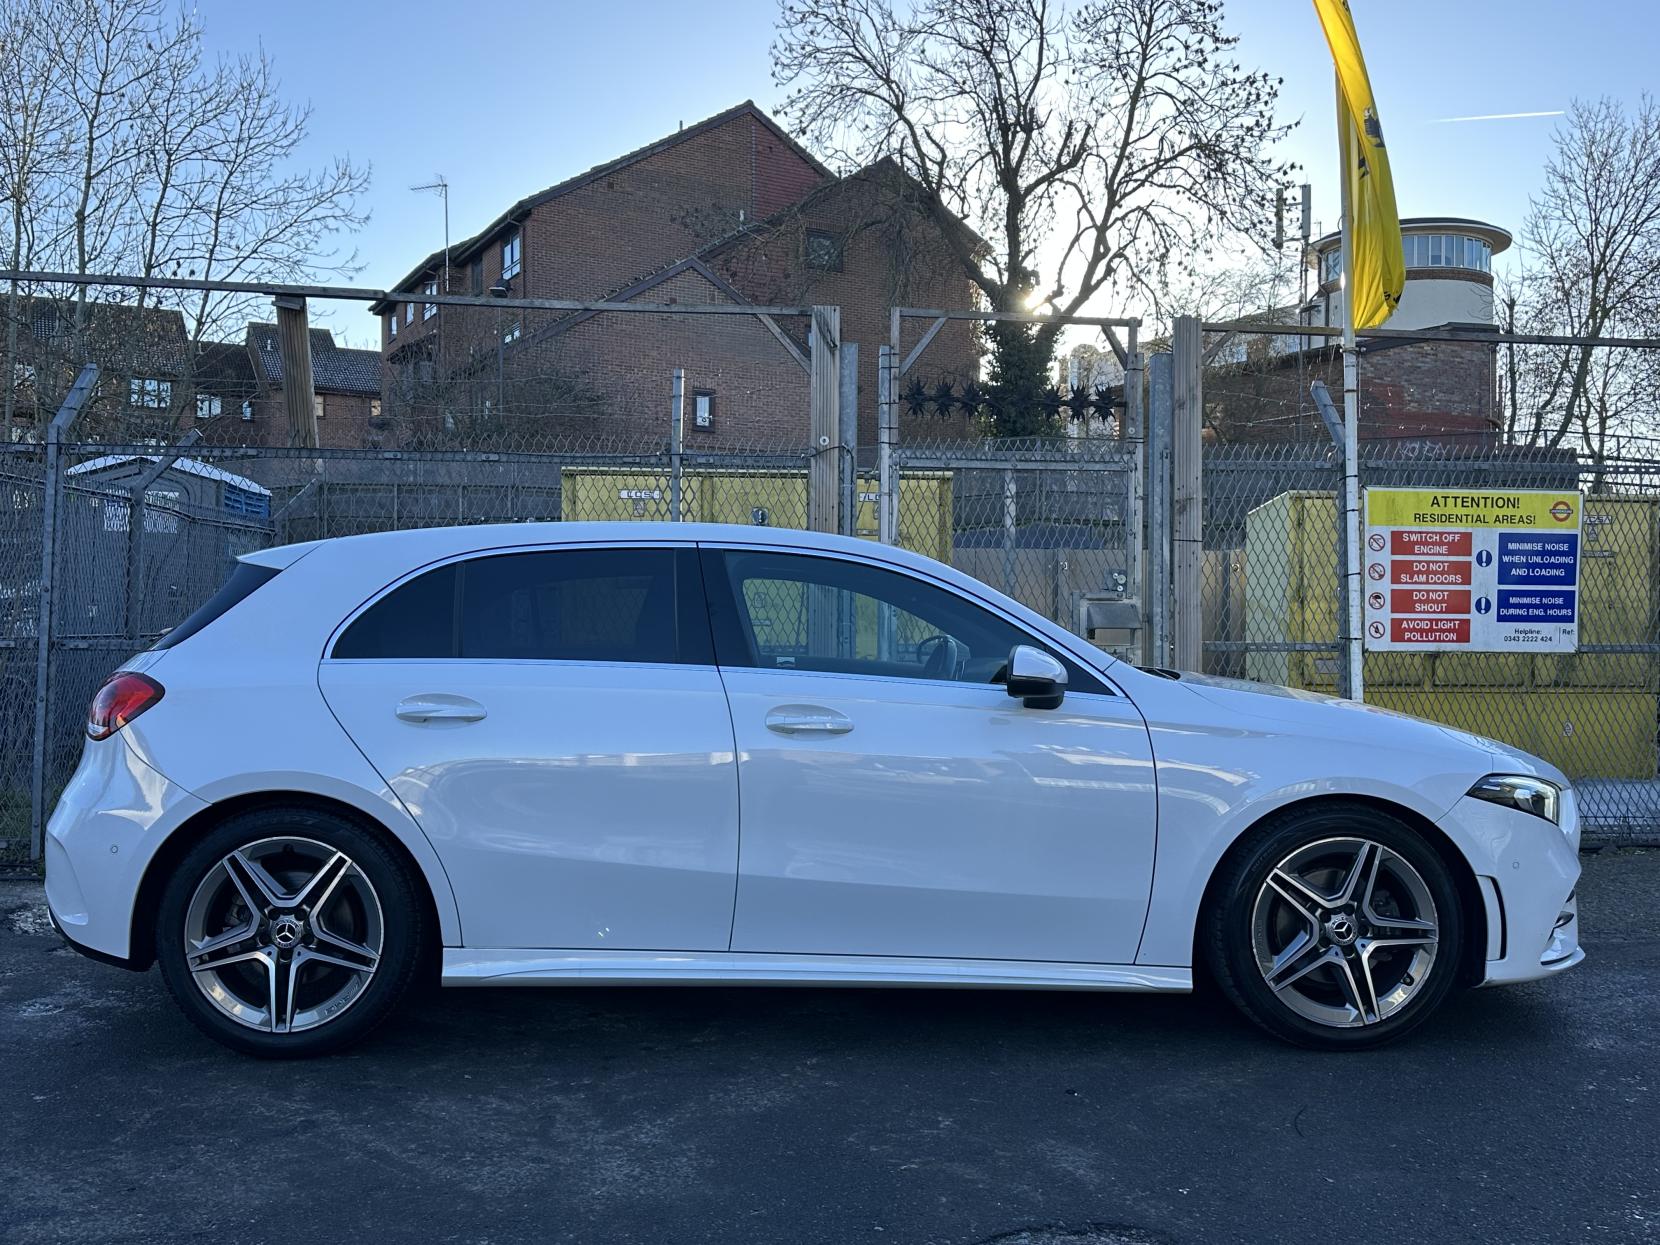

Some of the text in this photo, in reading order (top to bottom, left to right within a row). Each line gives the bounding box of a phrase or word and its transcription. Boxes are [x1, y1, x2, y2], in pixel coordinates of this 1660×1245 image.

[1430, 495, 1521, 509] ATTENTION!
[1413, 512, 1536, 525] RESIDENTIAL AREAS!
[1402, 533, 1461, 542] SWITCH OFF
[1414, 545, 1449, 554] ENGINE
[1507, 542, 1569, 551] MINIMISE NOISE
[1502, 555, 1574, 564] WHEN UNLOADING
[1413, 562, 1450, 571] DO NOT
[1510, 568, 1565, 576] AND LOADING
[1400, 573, 1462, 583] SLAM DOORS
[1413, 591, 1449, 600] DO NOT
[1509, 596, 1564, 605] MINIMISE NOISE
[1414, 603, 1448, 612] SHOUT
[1500, 608, 1572, 616] DURING ENG. HOURS
[1401, 620, 1460, 629] AVOID LIGHT
[1404, 632, 1457, 641] POLLUTION
[1514, 628, 1542, 636] Helpline:
